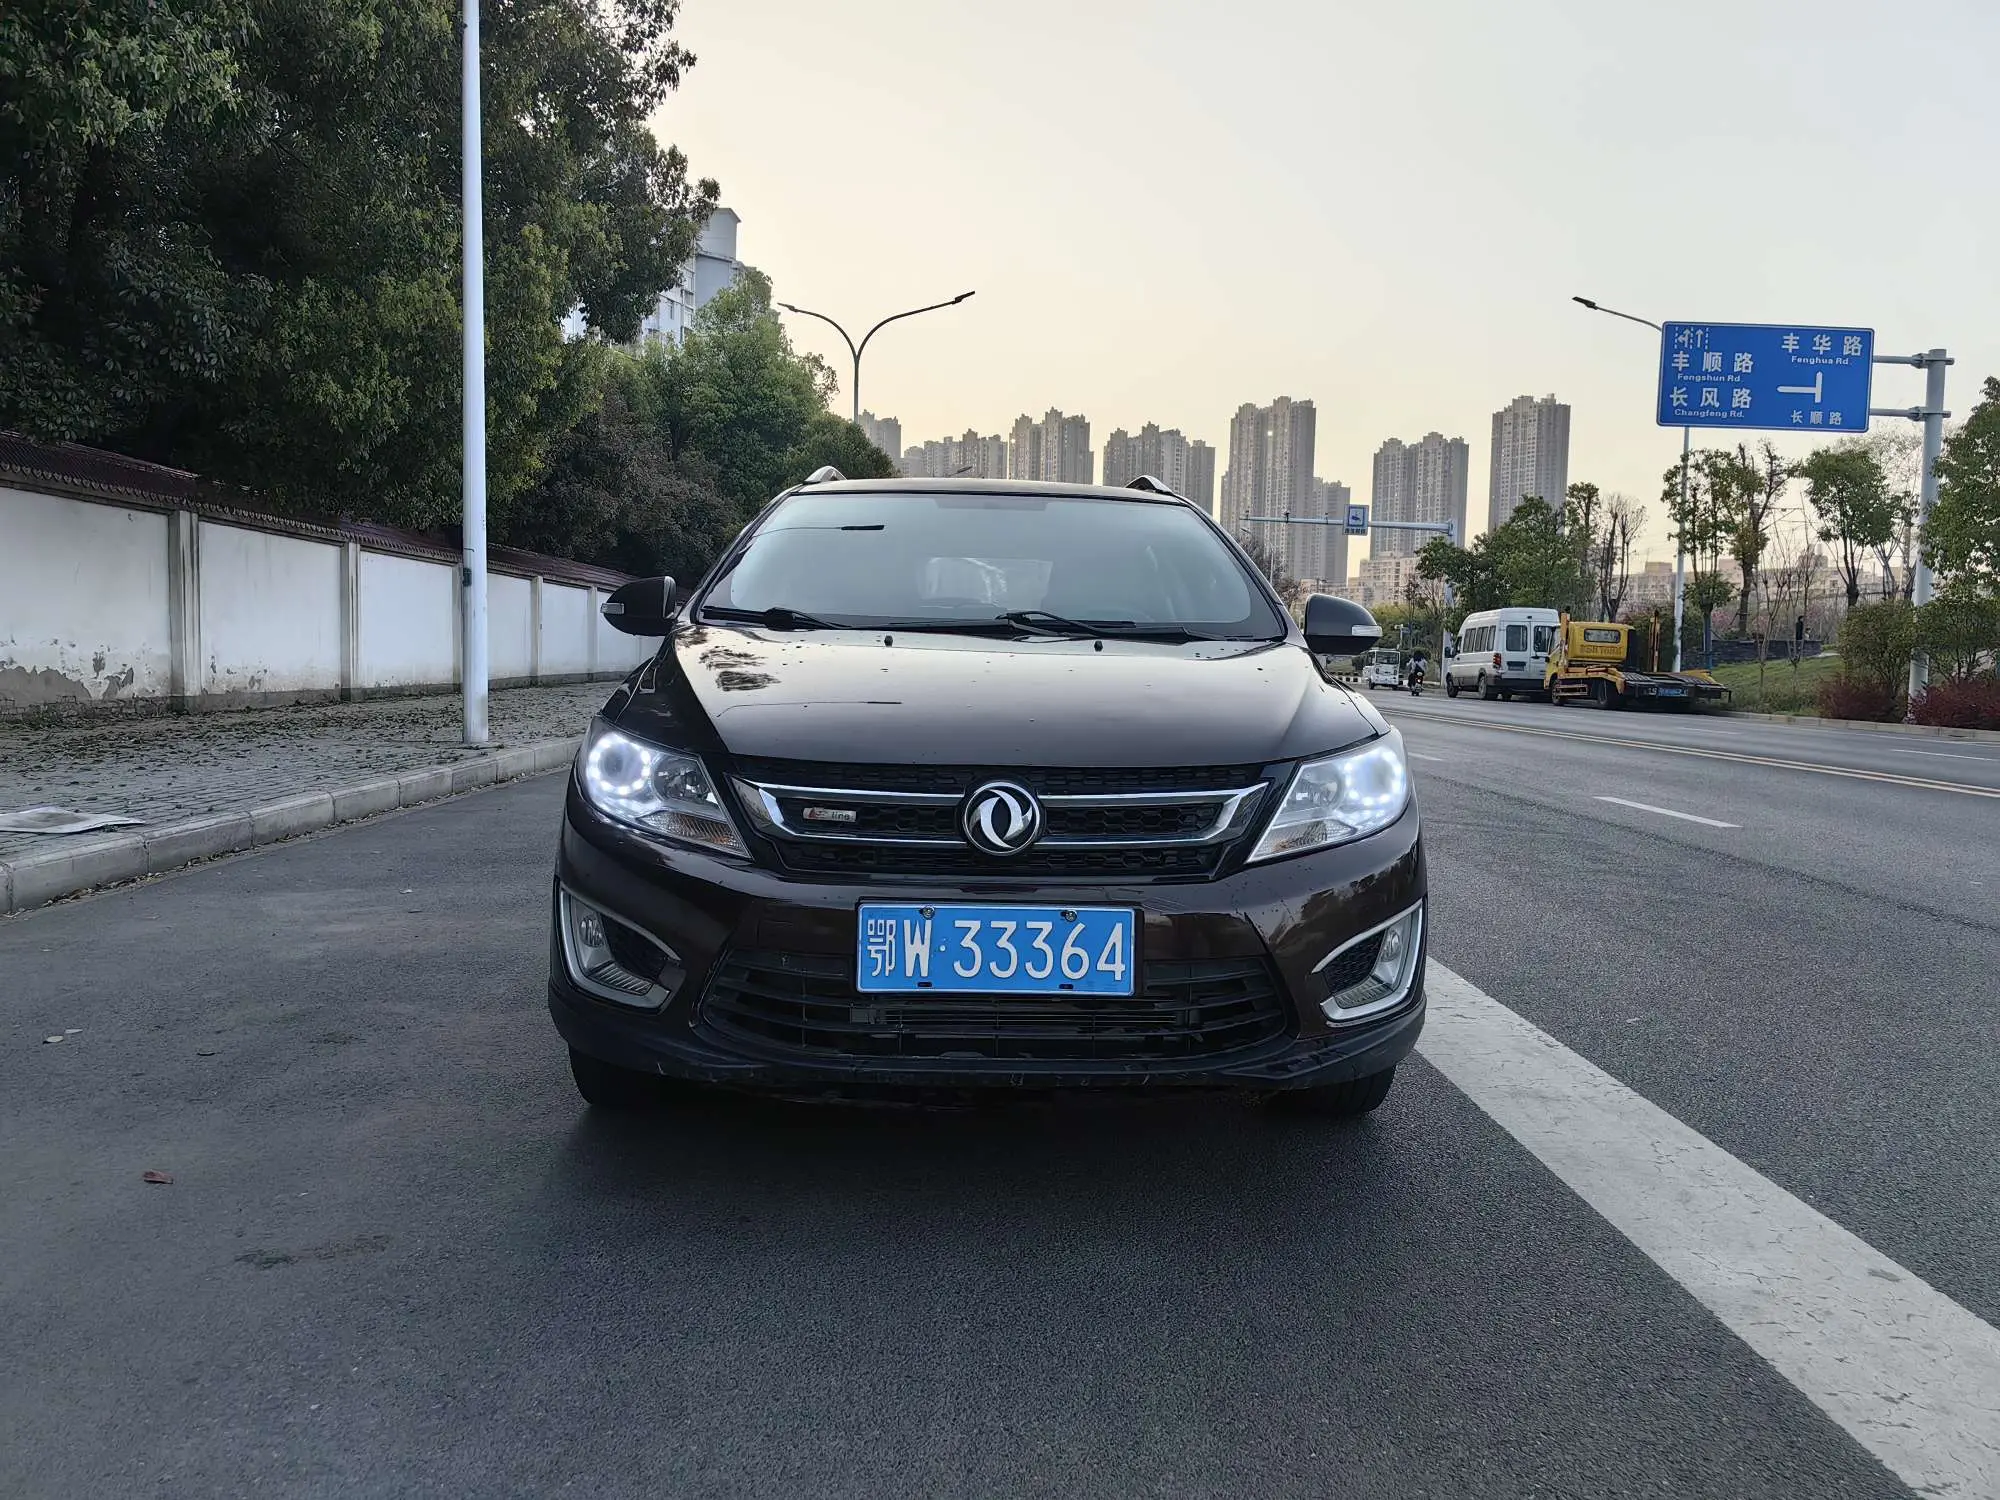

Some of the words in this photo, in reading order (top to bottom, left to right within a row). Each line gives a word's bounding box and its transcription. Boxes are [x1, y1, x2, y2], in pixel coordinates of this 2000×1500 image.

[1781, 333, 1863, 356] 丰华路
[1672, 351, 1754, 373] 丰顺路
[1791, 356, 1833, 365] Fenghua
[1677, 374, 1725, 382] Fengshun
[1670, 387, 1752, 409] 长风路
[1674, 409, 1727, 418] Changfeng
[1791, 410, 1842, 425] 长顺路
